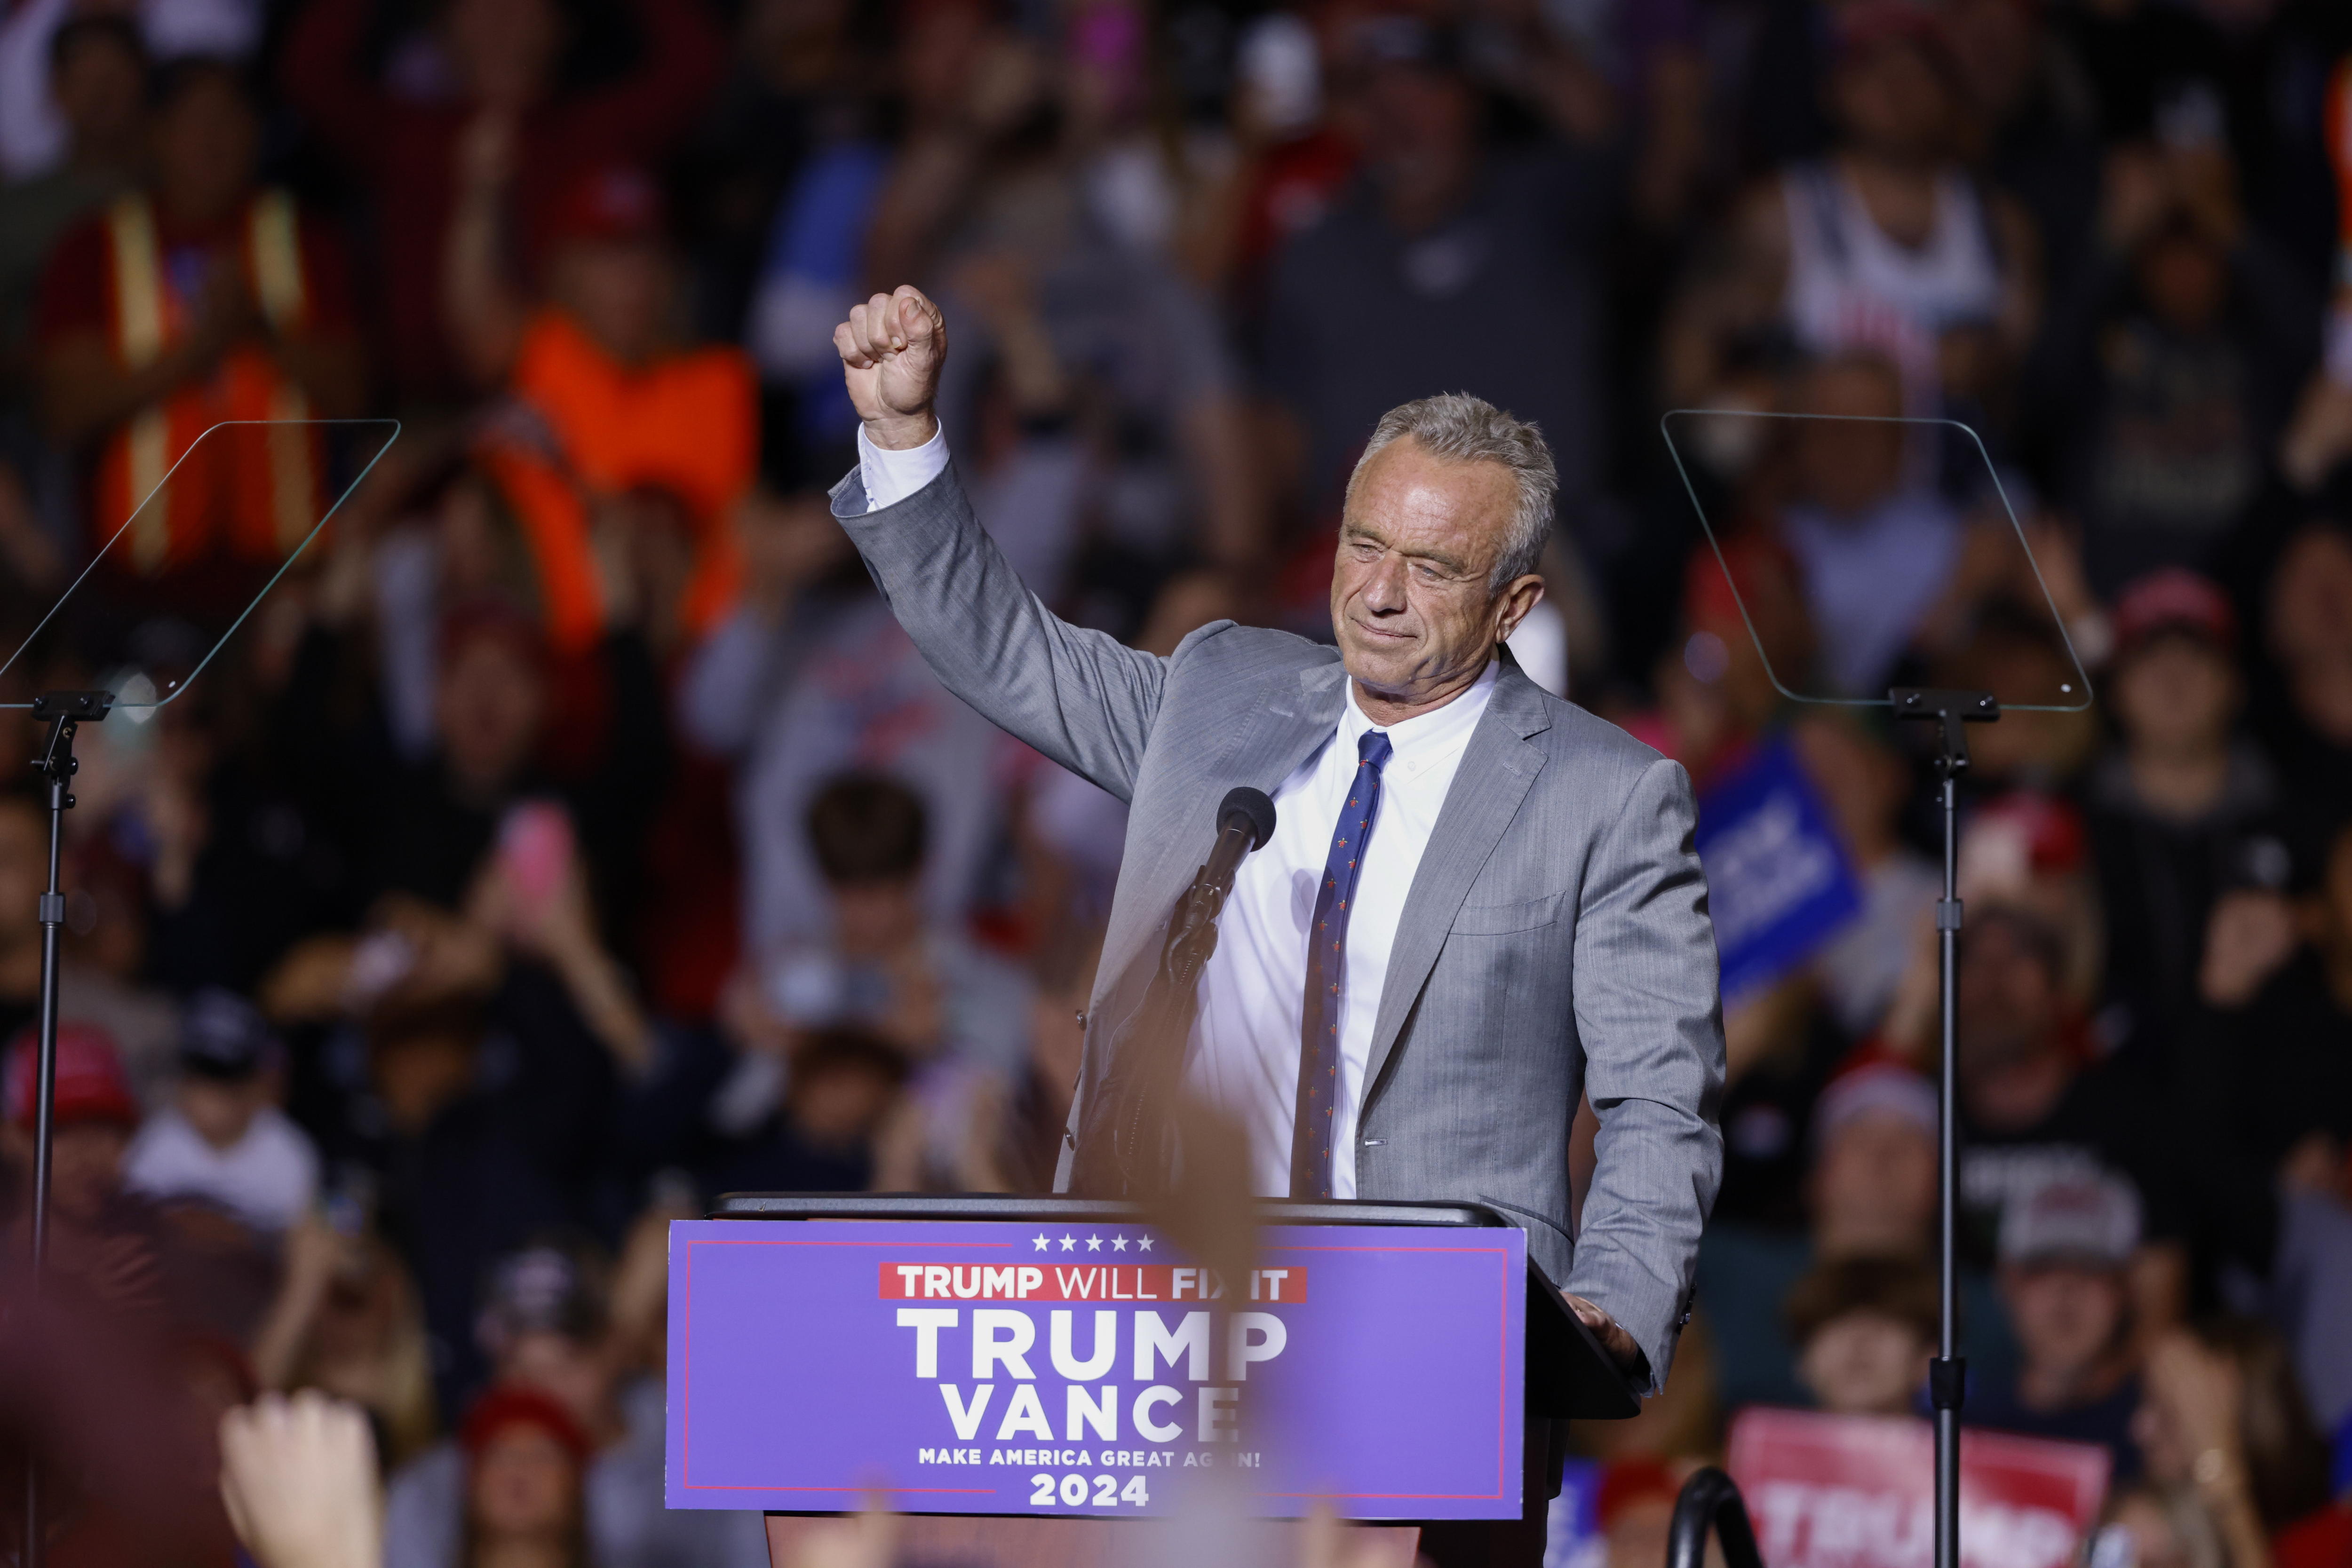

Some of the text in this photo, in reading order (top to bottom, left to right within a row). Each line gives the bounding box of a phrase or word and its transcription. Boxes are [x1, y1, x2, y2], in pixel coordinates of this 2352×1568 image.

[897, 1265, 1043, 1299] TRUMP
[1055, 1267, 1157, 1299] WILL
[1250, 1269, 1288, 1301] IT
[896, 1308, 1288, 1381] TRUMP
[938, 1384, 1240, 1443] VANCE
[918, 1448, 1261, 1468] MAKE AMERICA GREAT AGN!
[1030, 1473, 1150, 1507] 2024
